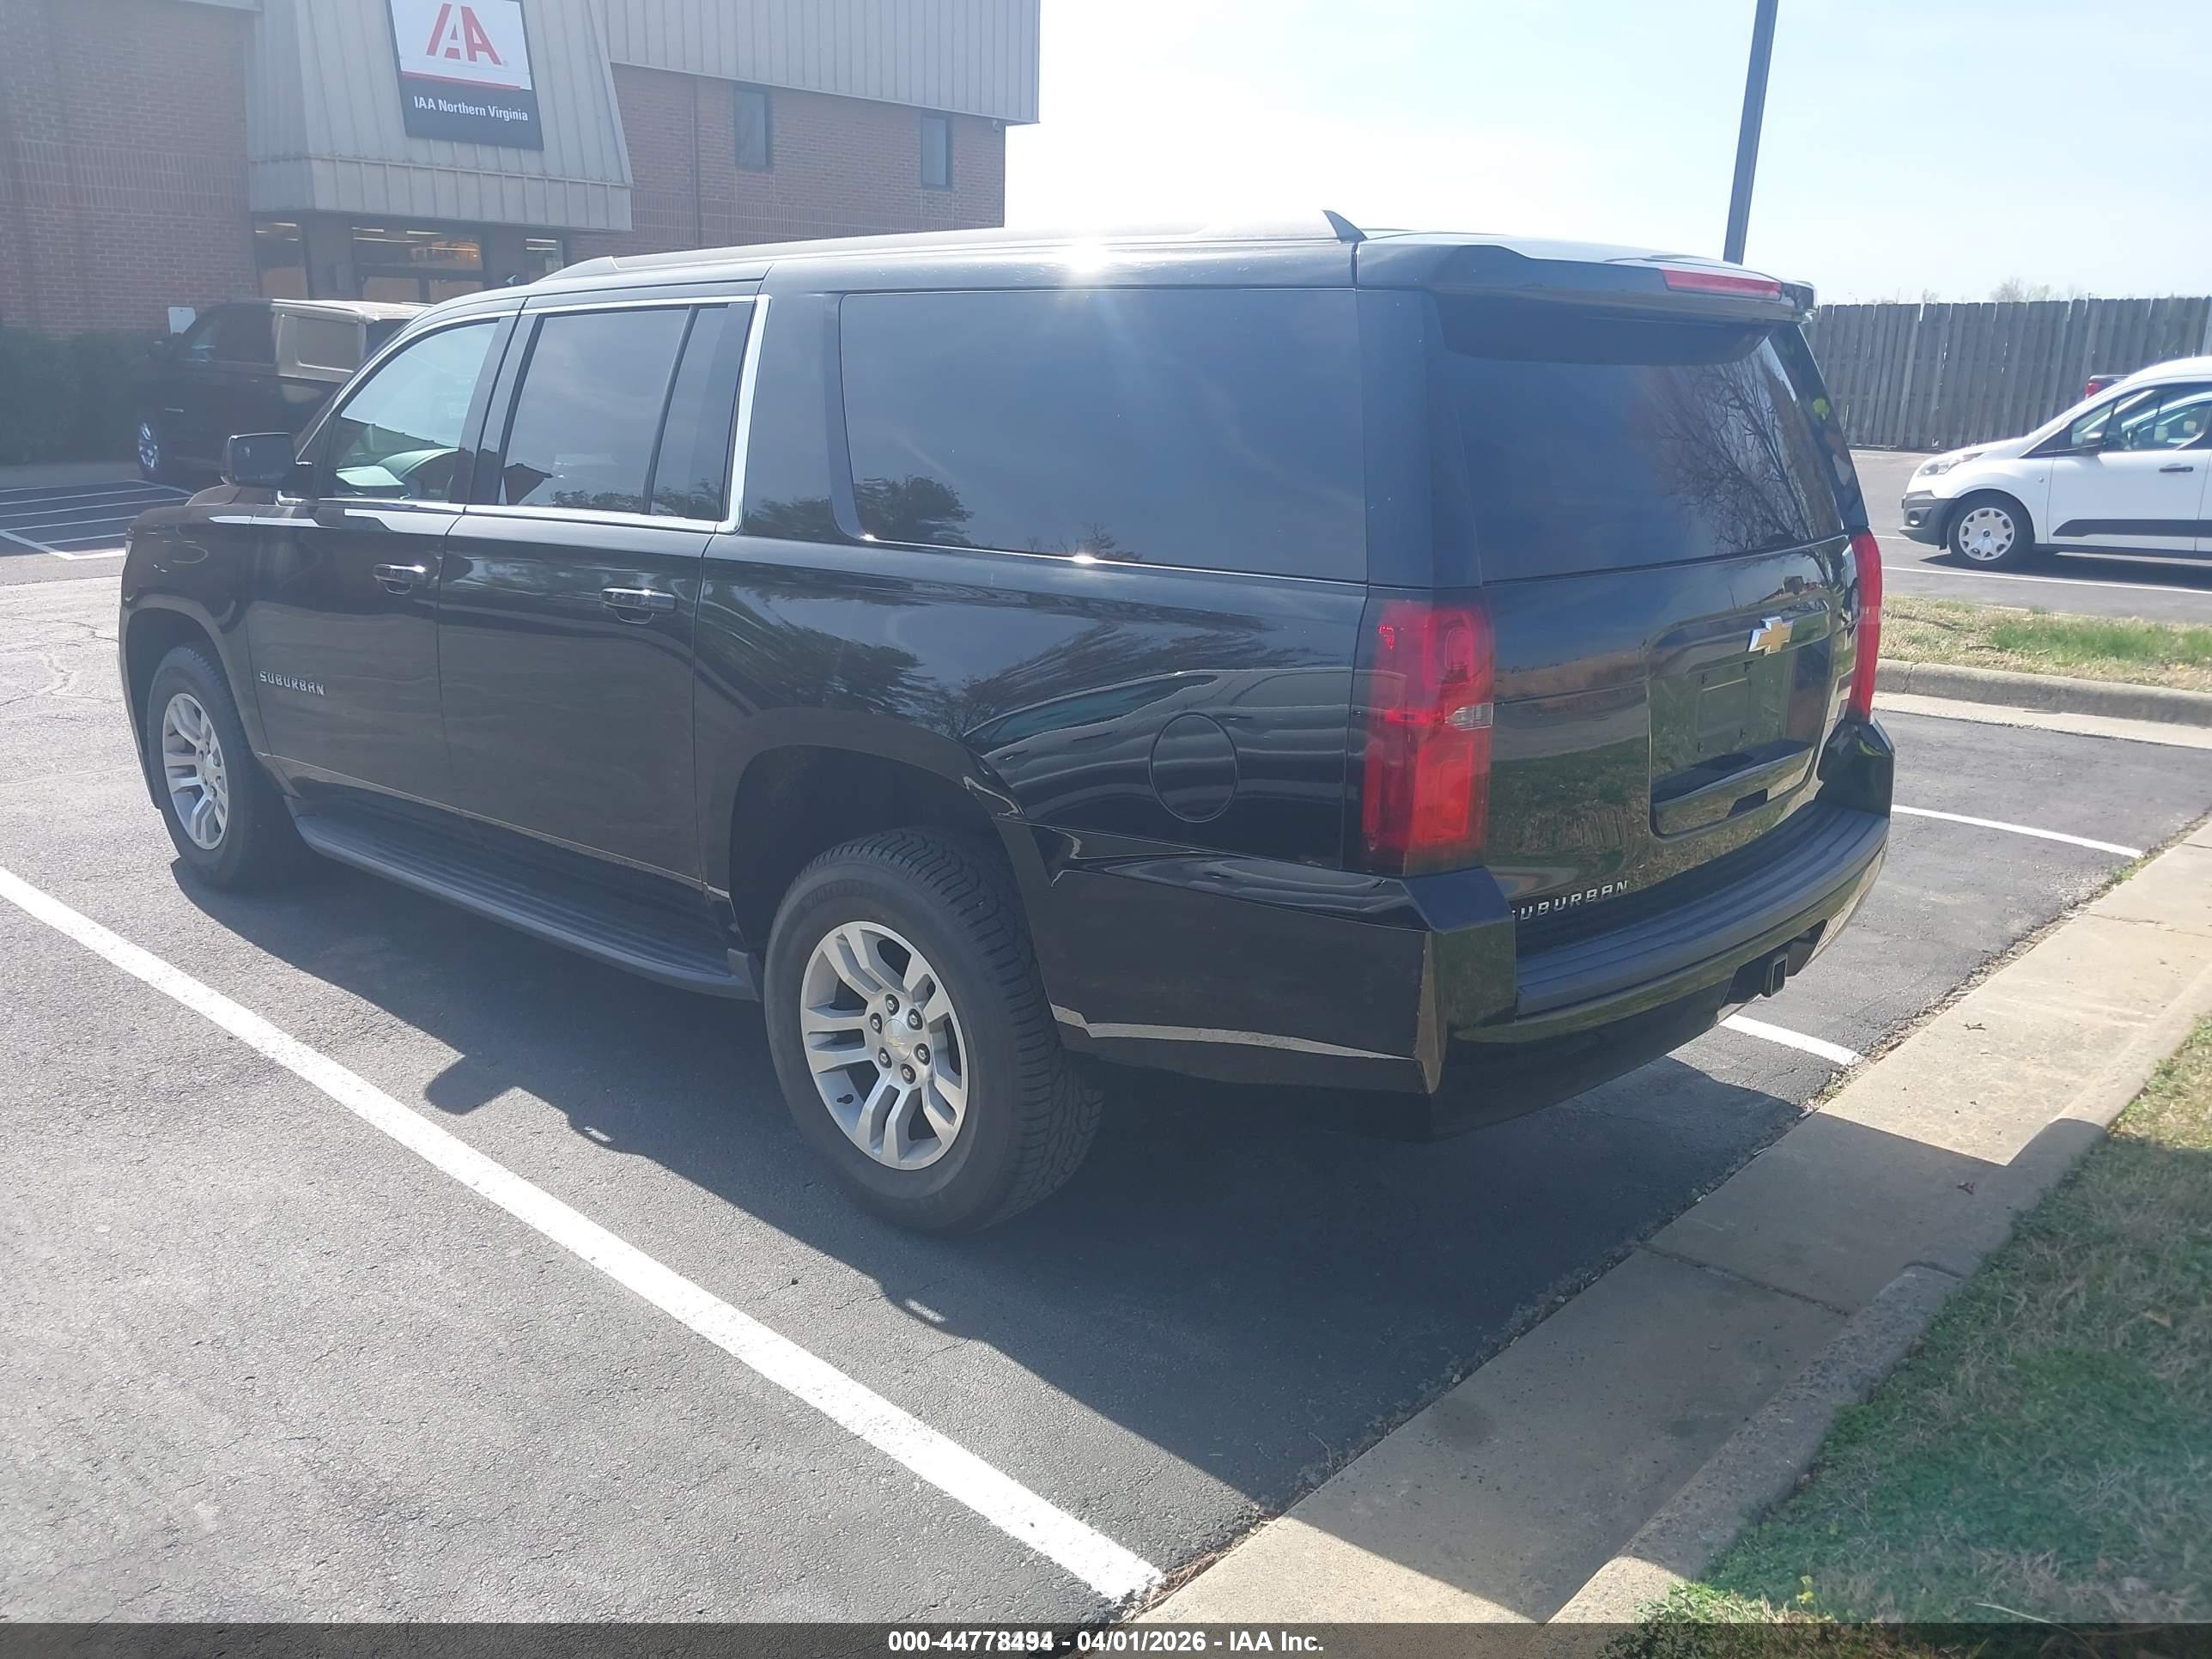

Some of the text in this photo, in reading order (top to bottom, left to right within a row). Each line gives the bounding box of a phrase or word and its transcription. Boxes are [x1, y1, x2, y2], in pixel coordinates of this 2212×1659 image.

[426, 3, 502, 65] IAA
[414, 95, 529, 122] IAA Northern Virginia
[259, 671, 325, 696] SUBURBAN
[1511, 879, 1629, 921] UBURBAN
